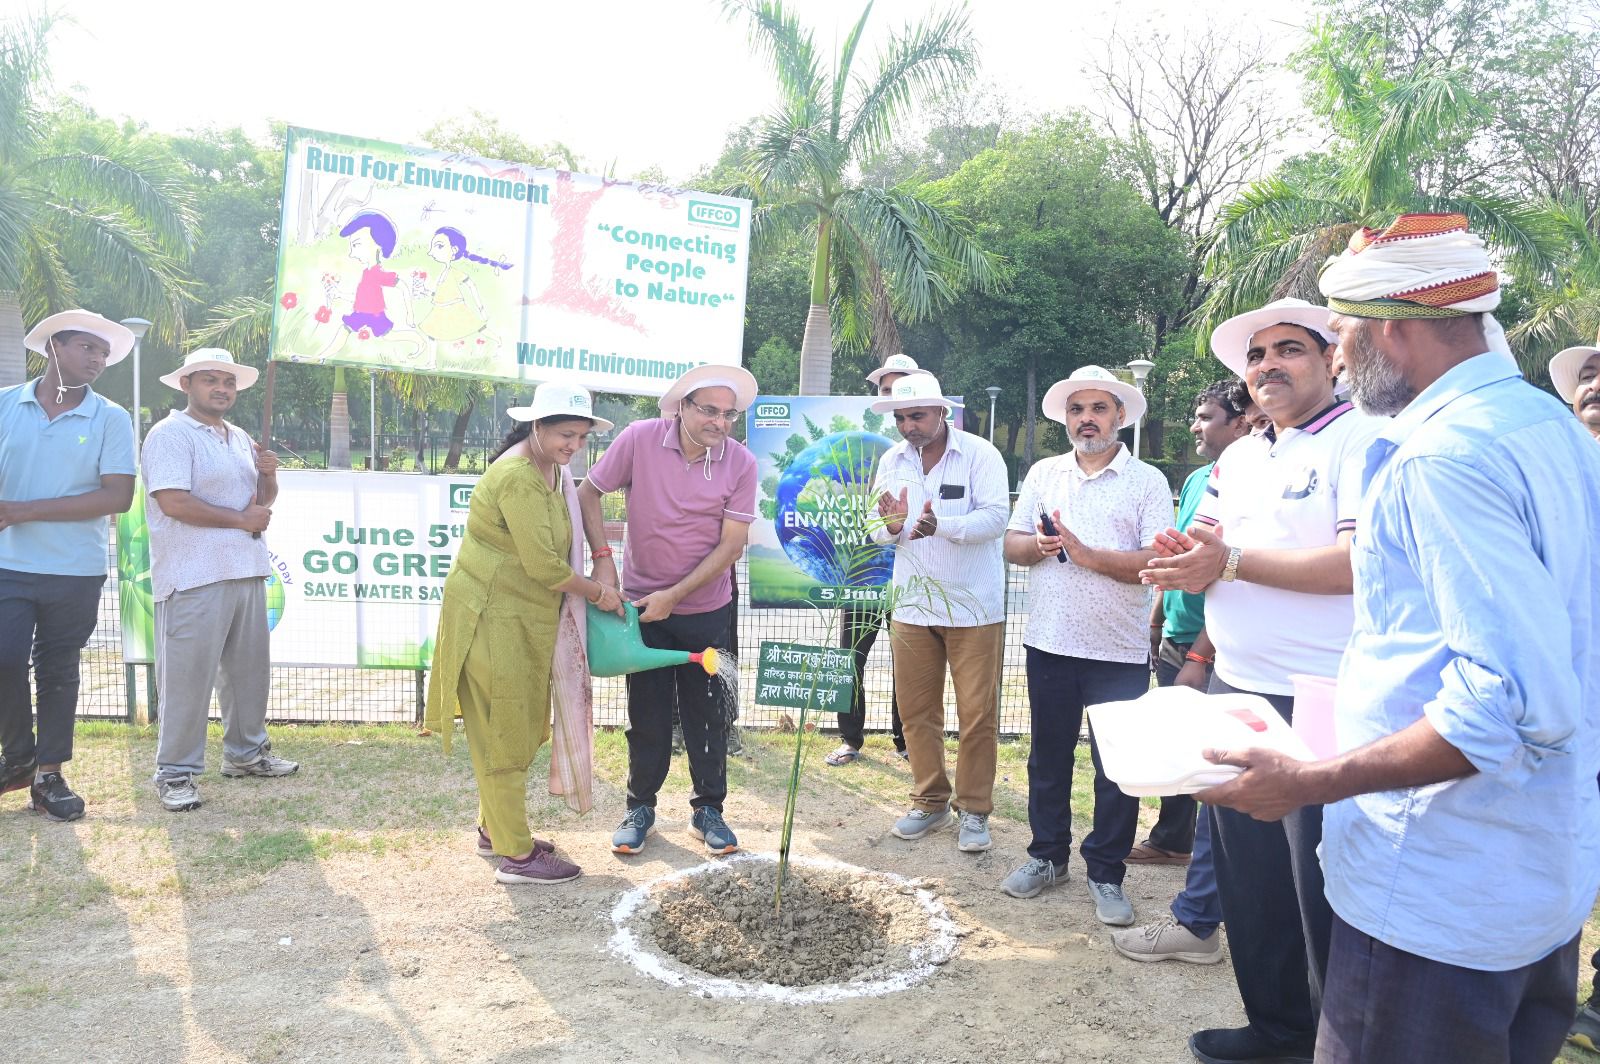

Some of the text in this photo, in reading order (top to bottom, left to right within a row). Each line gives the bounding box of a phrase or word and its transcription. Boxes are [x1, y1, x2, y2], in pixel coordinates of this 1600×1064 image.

[307, 147, 549, 204] Run For Environment
[696, 207, 733, 222] IFFCO
[626, 254, 706, 282] People
[615, 279, 639, 298] to
[516, 342, 575, 369] World
[760, 406, 785, 415] IFFCO
[459, 490, 472, 503] IF
[323, 520, 415, 546] June
[834, 530, 867, 545] DAY
[277, 561, 294, 585] Day
[303, 550, 358, 575] GO
[373, 551, 451, 577] GRE
[304, 582, 444, 600] SAVE WATER SA
[820, 588, 835, 600] 5
[766, 644, 781, 663] श्री
[763, 667, 786, 680] वरिष्ठ
[760, 681, 839, 705] द्वारा रोपित वृक्ष
